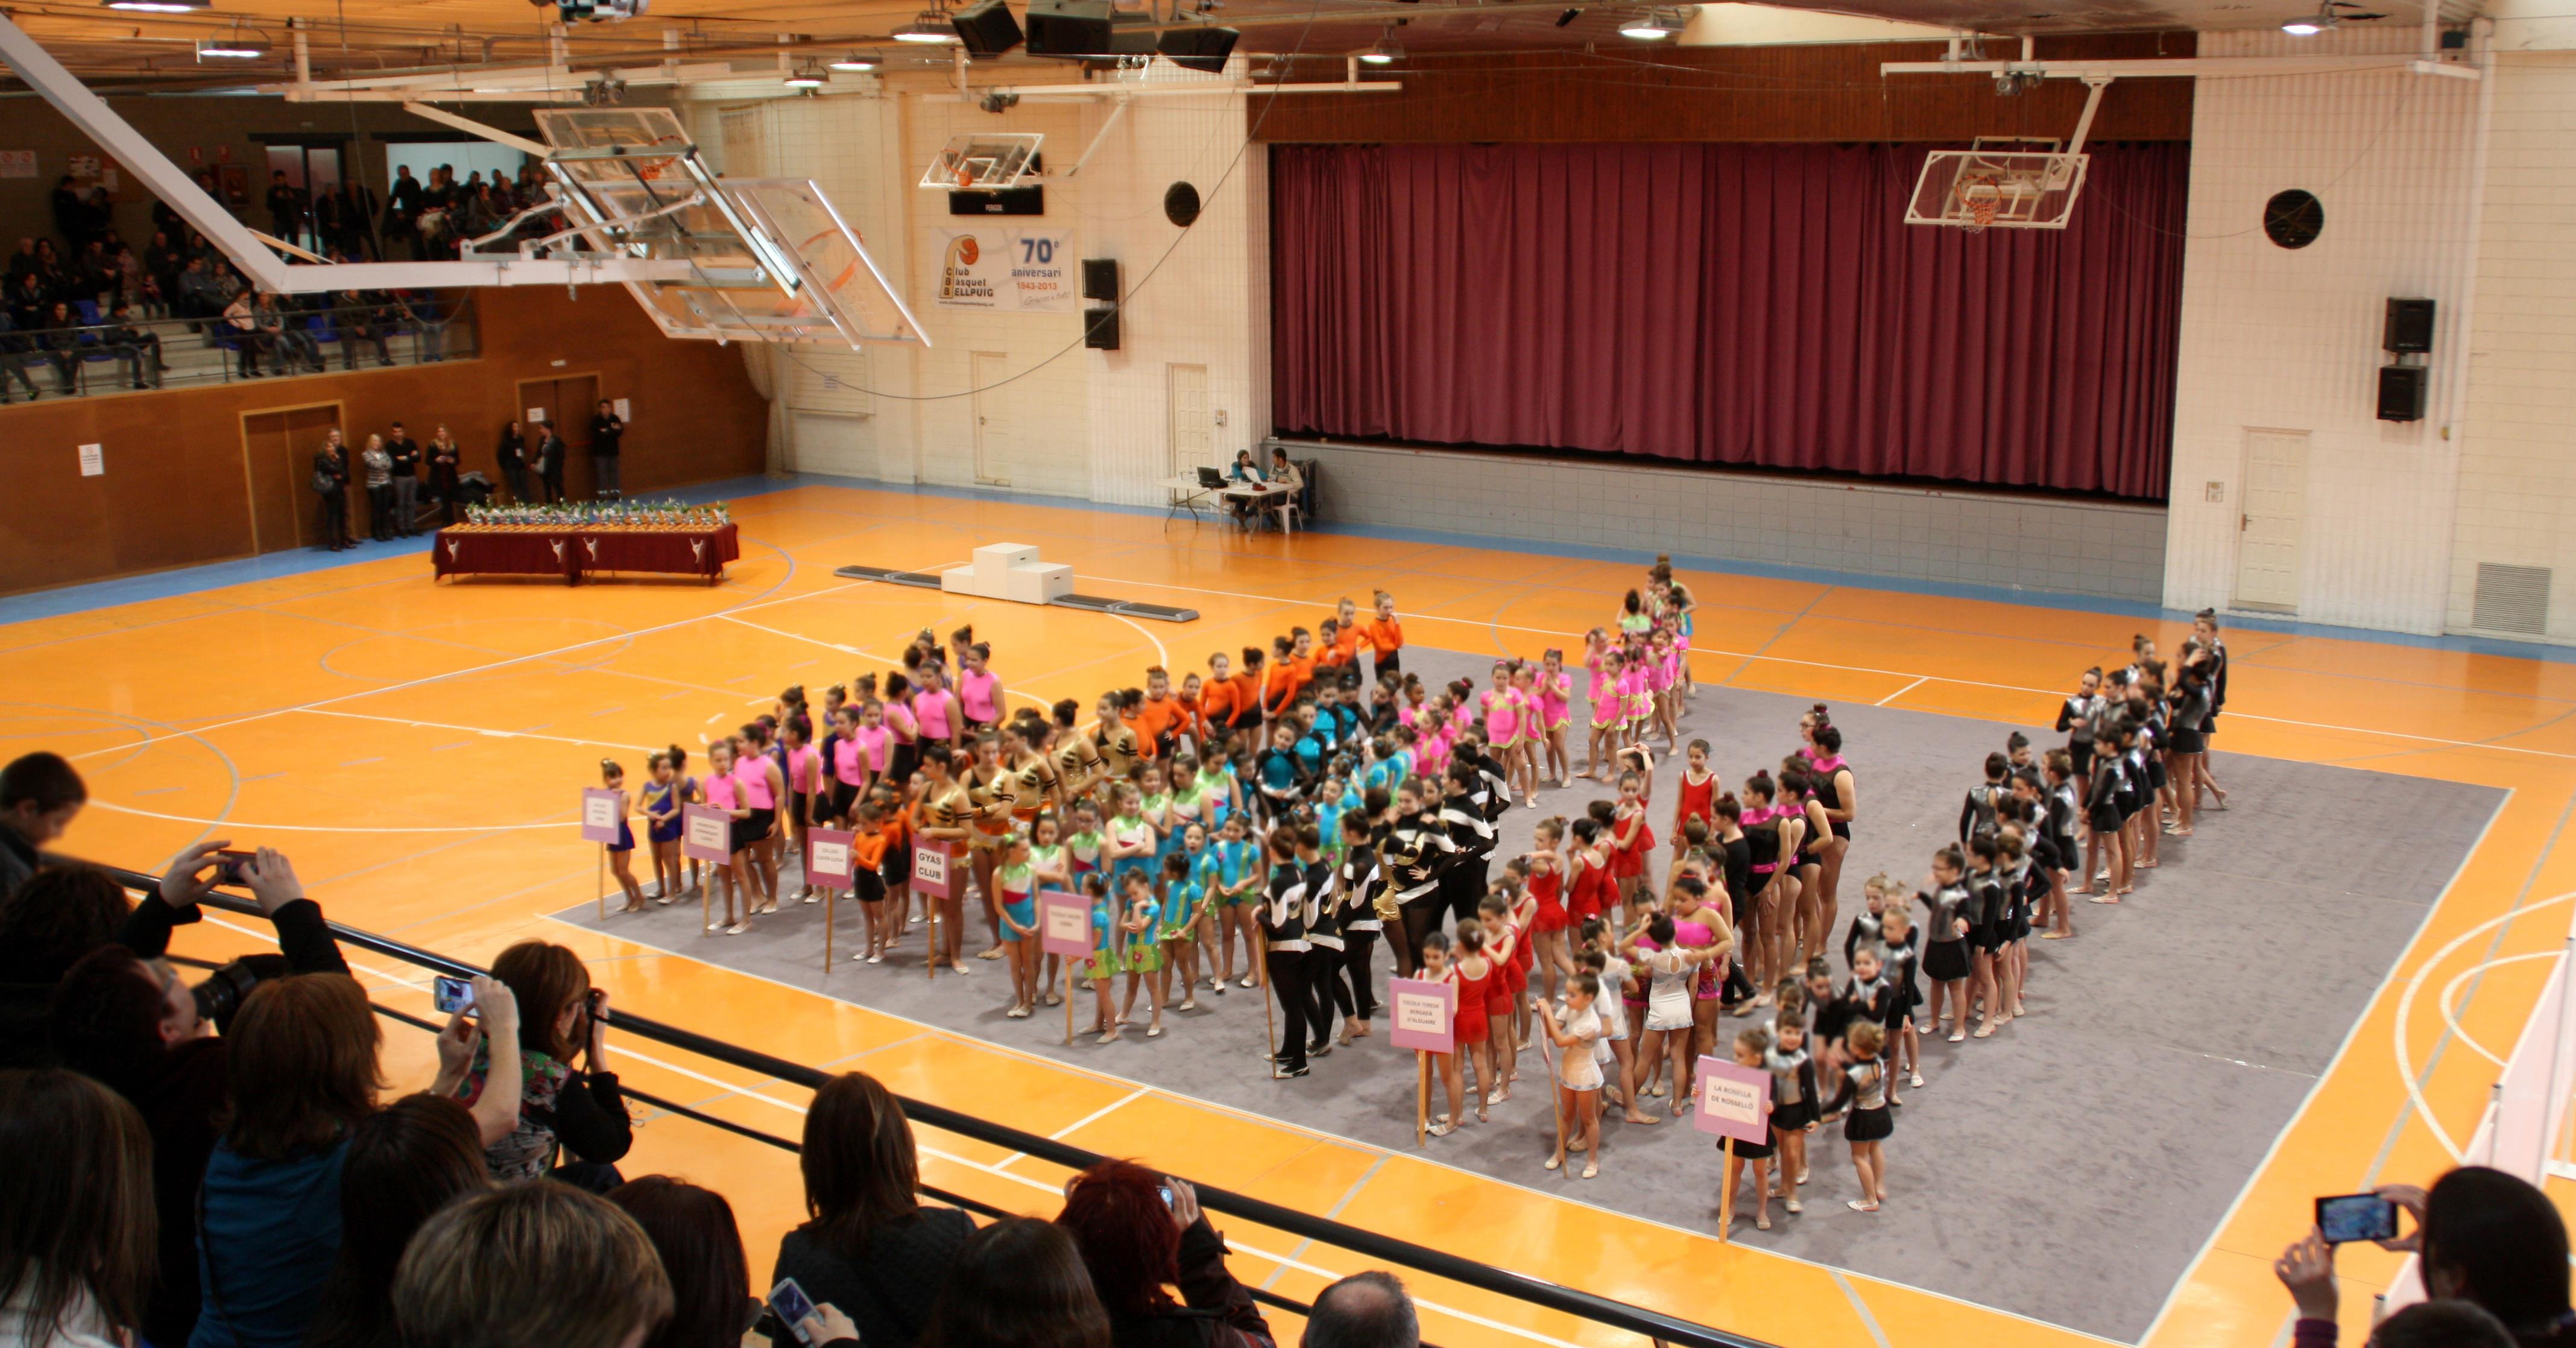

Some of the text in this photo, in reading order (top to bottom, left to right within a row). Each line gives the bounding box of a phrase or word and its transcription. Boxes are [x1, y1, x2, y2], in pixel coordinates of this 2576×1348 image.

[1012, 267, 1061, 277] aniversari
[918, 853, 941, 865] GYAS
[918, 867, 941, 879] CLUB
[1723, 1087, 1752, 1098] ROSELLA
[1721, 1097, 1754, 1110] ROSSELLÓ
